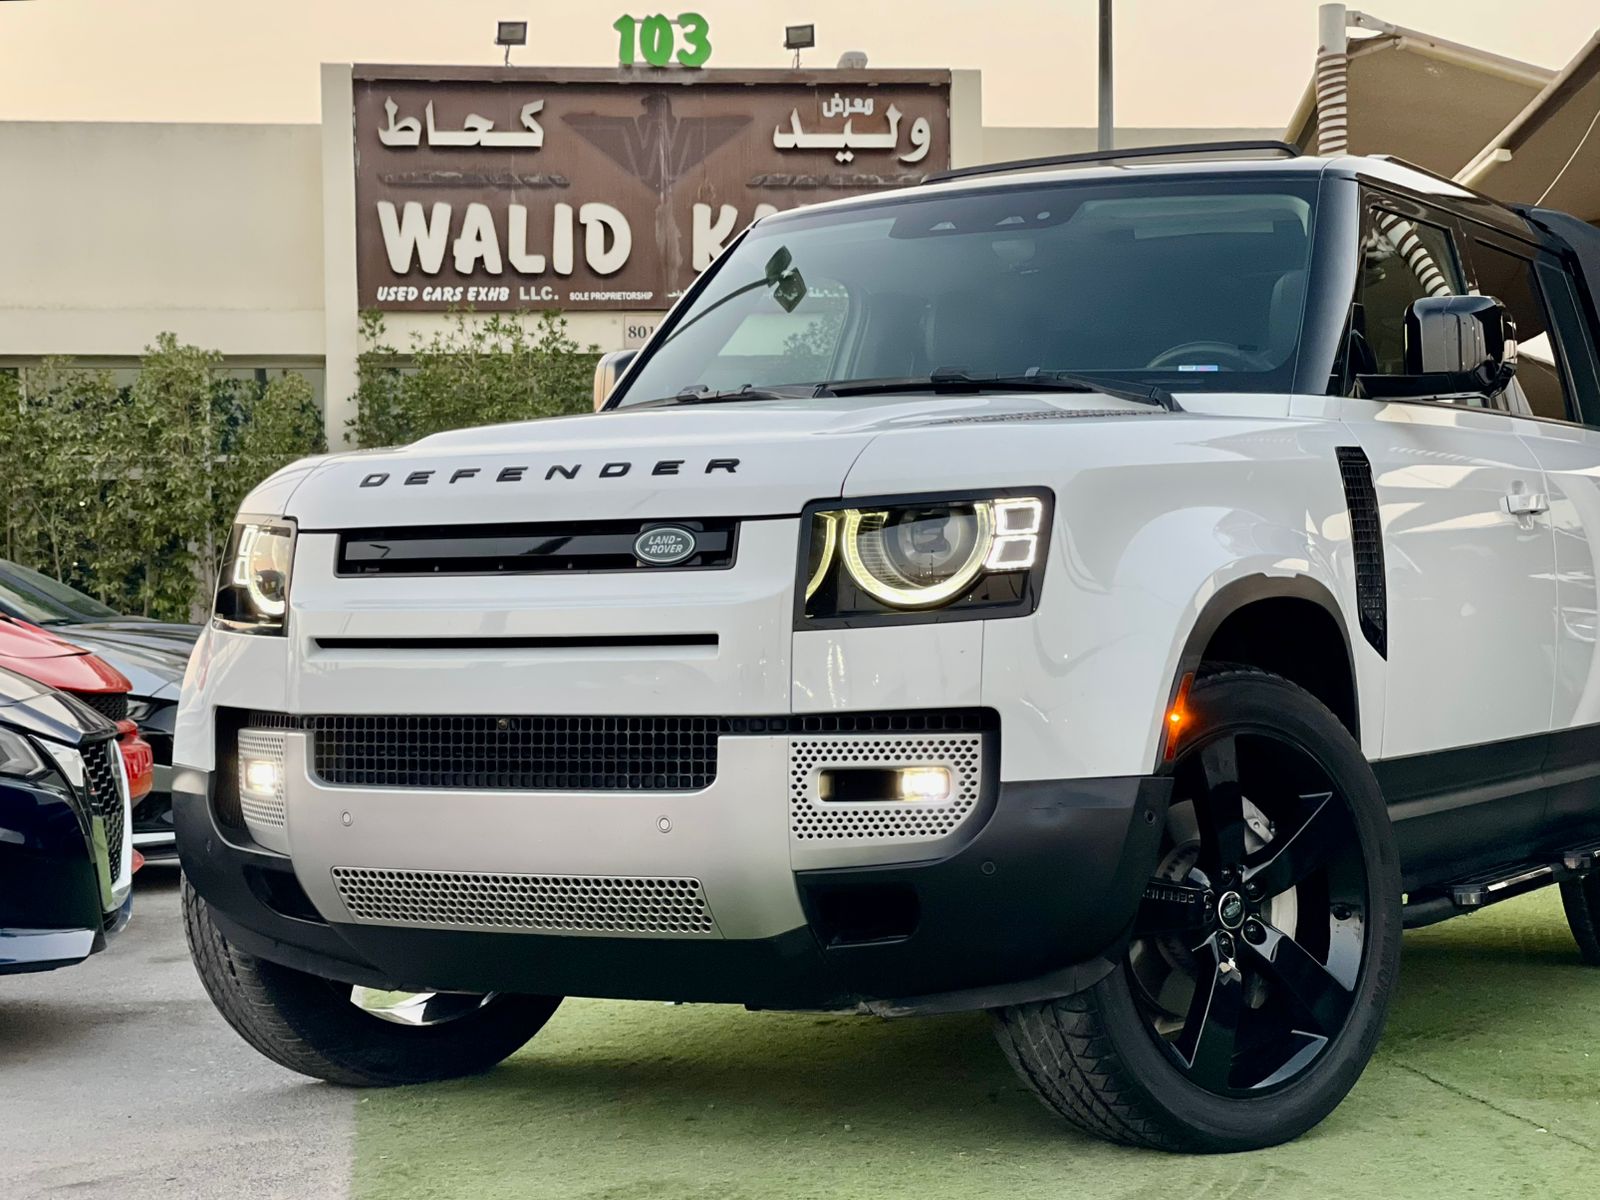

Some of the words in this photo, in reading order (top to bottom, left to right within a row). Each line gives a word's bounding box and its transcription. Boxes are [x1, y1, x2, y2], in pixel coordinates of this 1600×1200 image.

[613, 13, 712, 67] 103
[378, 96, 544, 147] كحاط
[823, 93, 874, 117] معرض
[773, 103, 931, 163] وليد
[377, 202, 632, 275] WALID
[377, 286, 418, 301] USED
[422, 286, 464, 302] CARS
[467, 286, 510, 301] EXHB
[519, 286, 559, 300] LLC.
[569, 292, 590, 301] SOLE
[590, 291, 654, 300] PROPRIETORSHIP
[359, 458, 742, 487] DEFENDER
